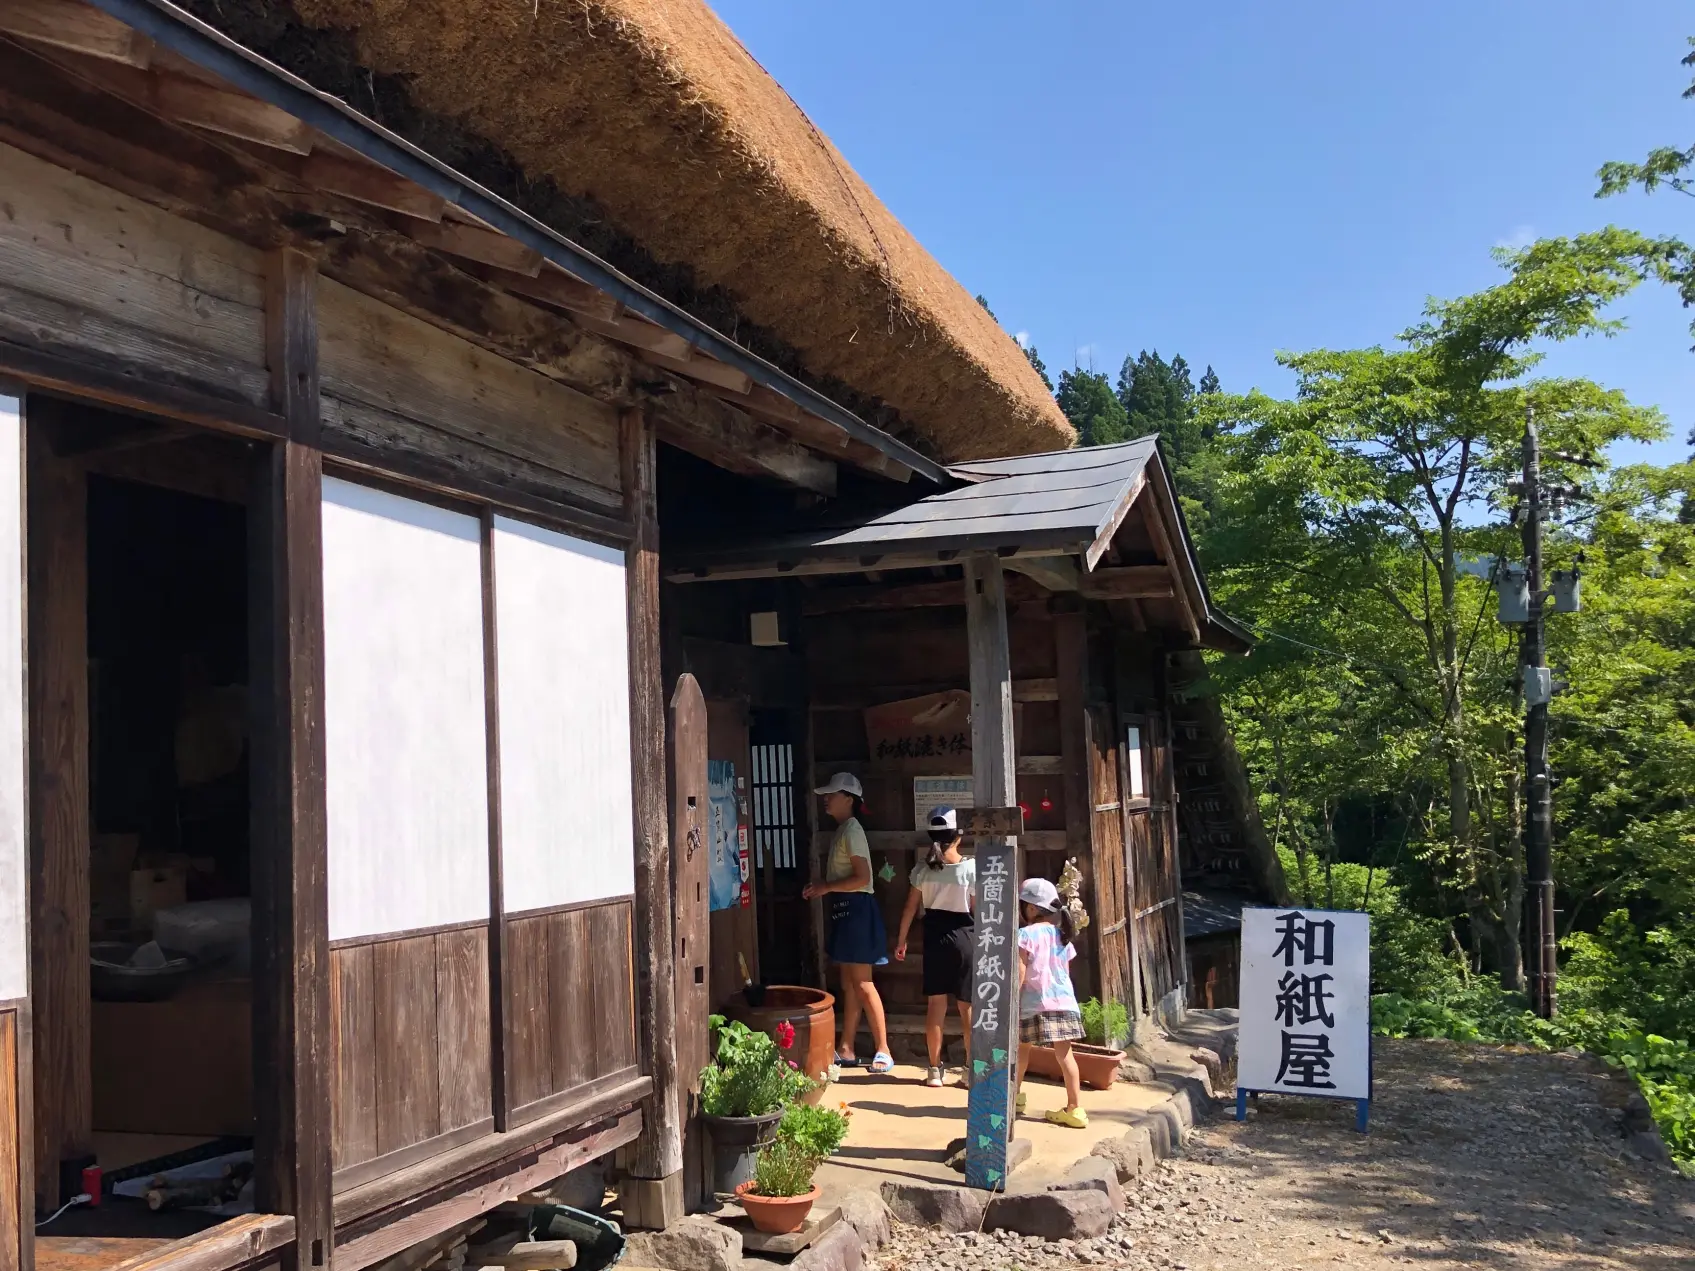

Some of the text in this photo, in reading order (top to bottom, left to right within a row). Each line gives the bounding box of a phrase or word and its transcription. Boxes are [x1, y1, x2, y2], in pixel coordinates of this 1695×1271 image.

[973, 855, 1008, 1031] 五箇山和紙の店
[1272, 911, 1337, 1089] 和紙屋
